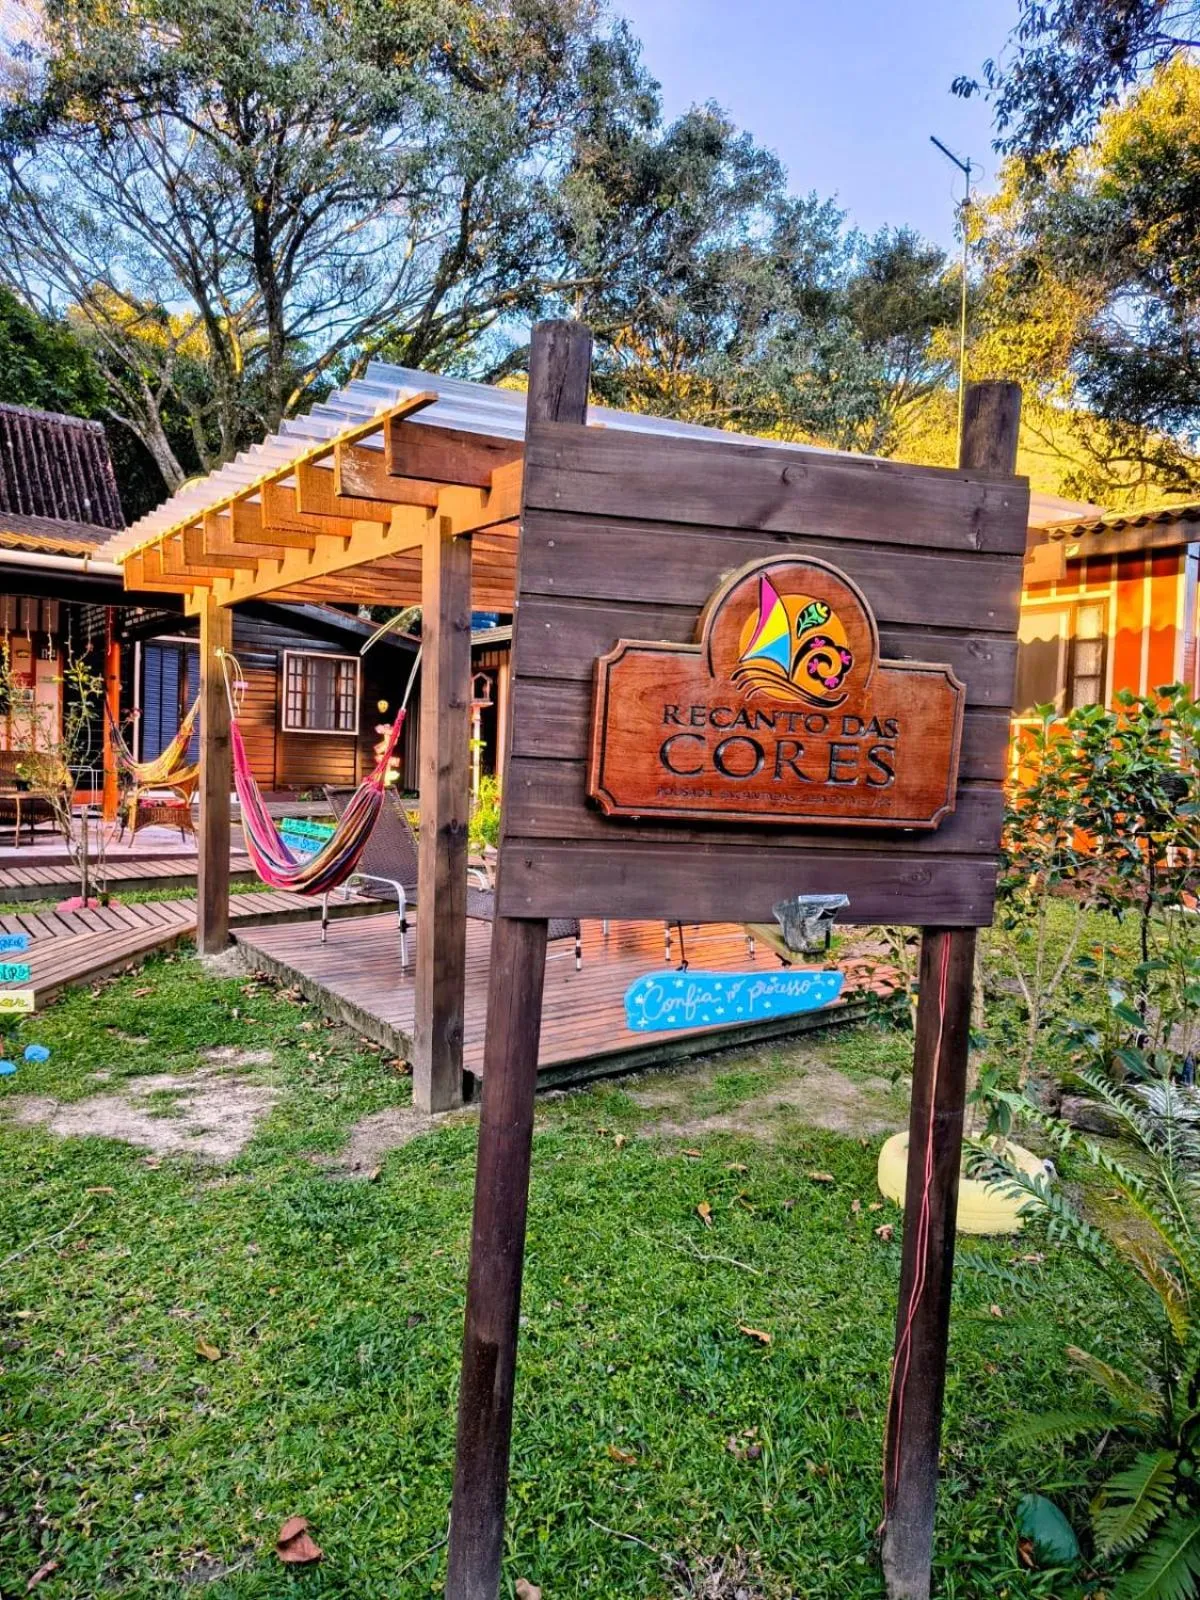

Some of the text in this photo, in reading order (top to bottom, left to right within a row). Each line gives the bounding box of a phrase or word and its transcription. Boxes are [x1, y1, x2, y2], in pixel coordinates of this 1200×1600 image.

[662, 703, 899, 739] RECANTO DAS
[659, 733, 896, 788] CORES
[655, 785, 713, 798] POUSADA
[642, 984, 721, 1020] Confia
